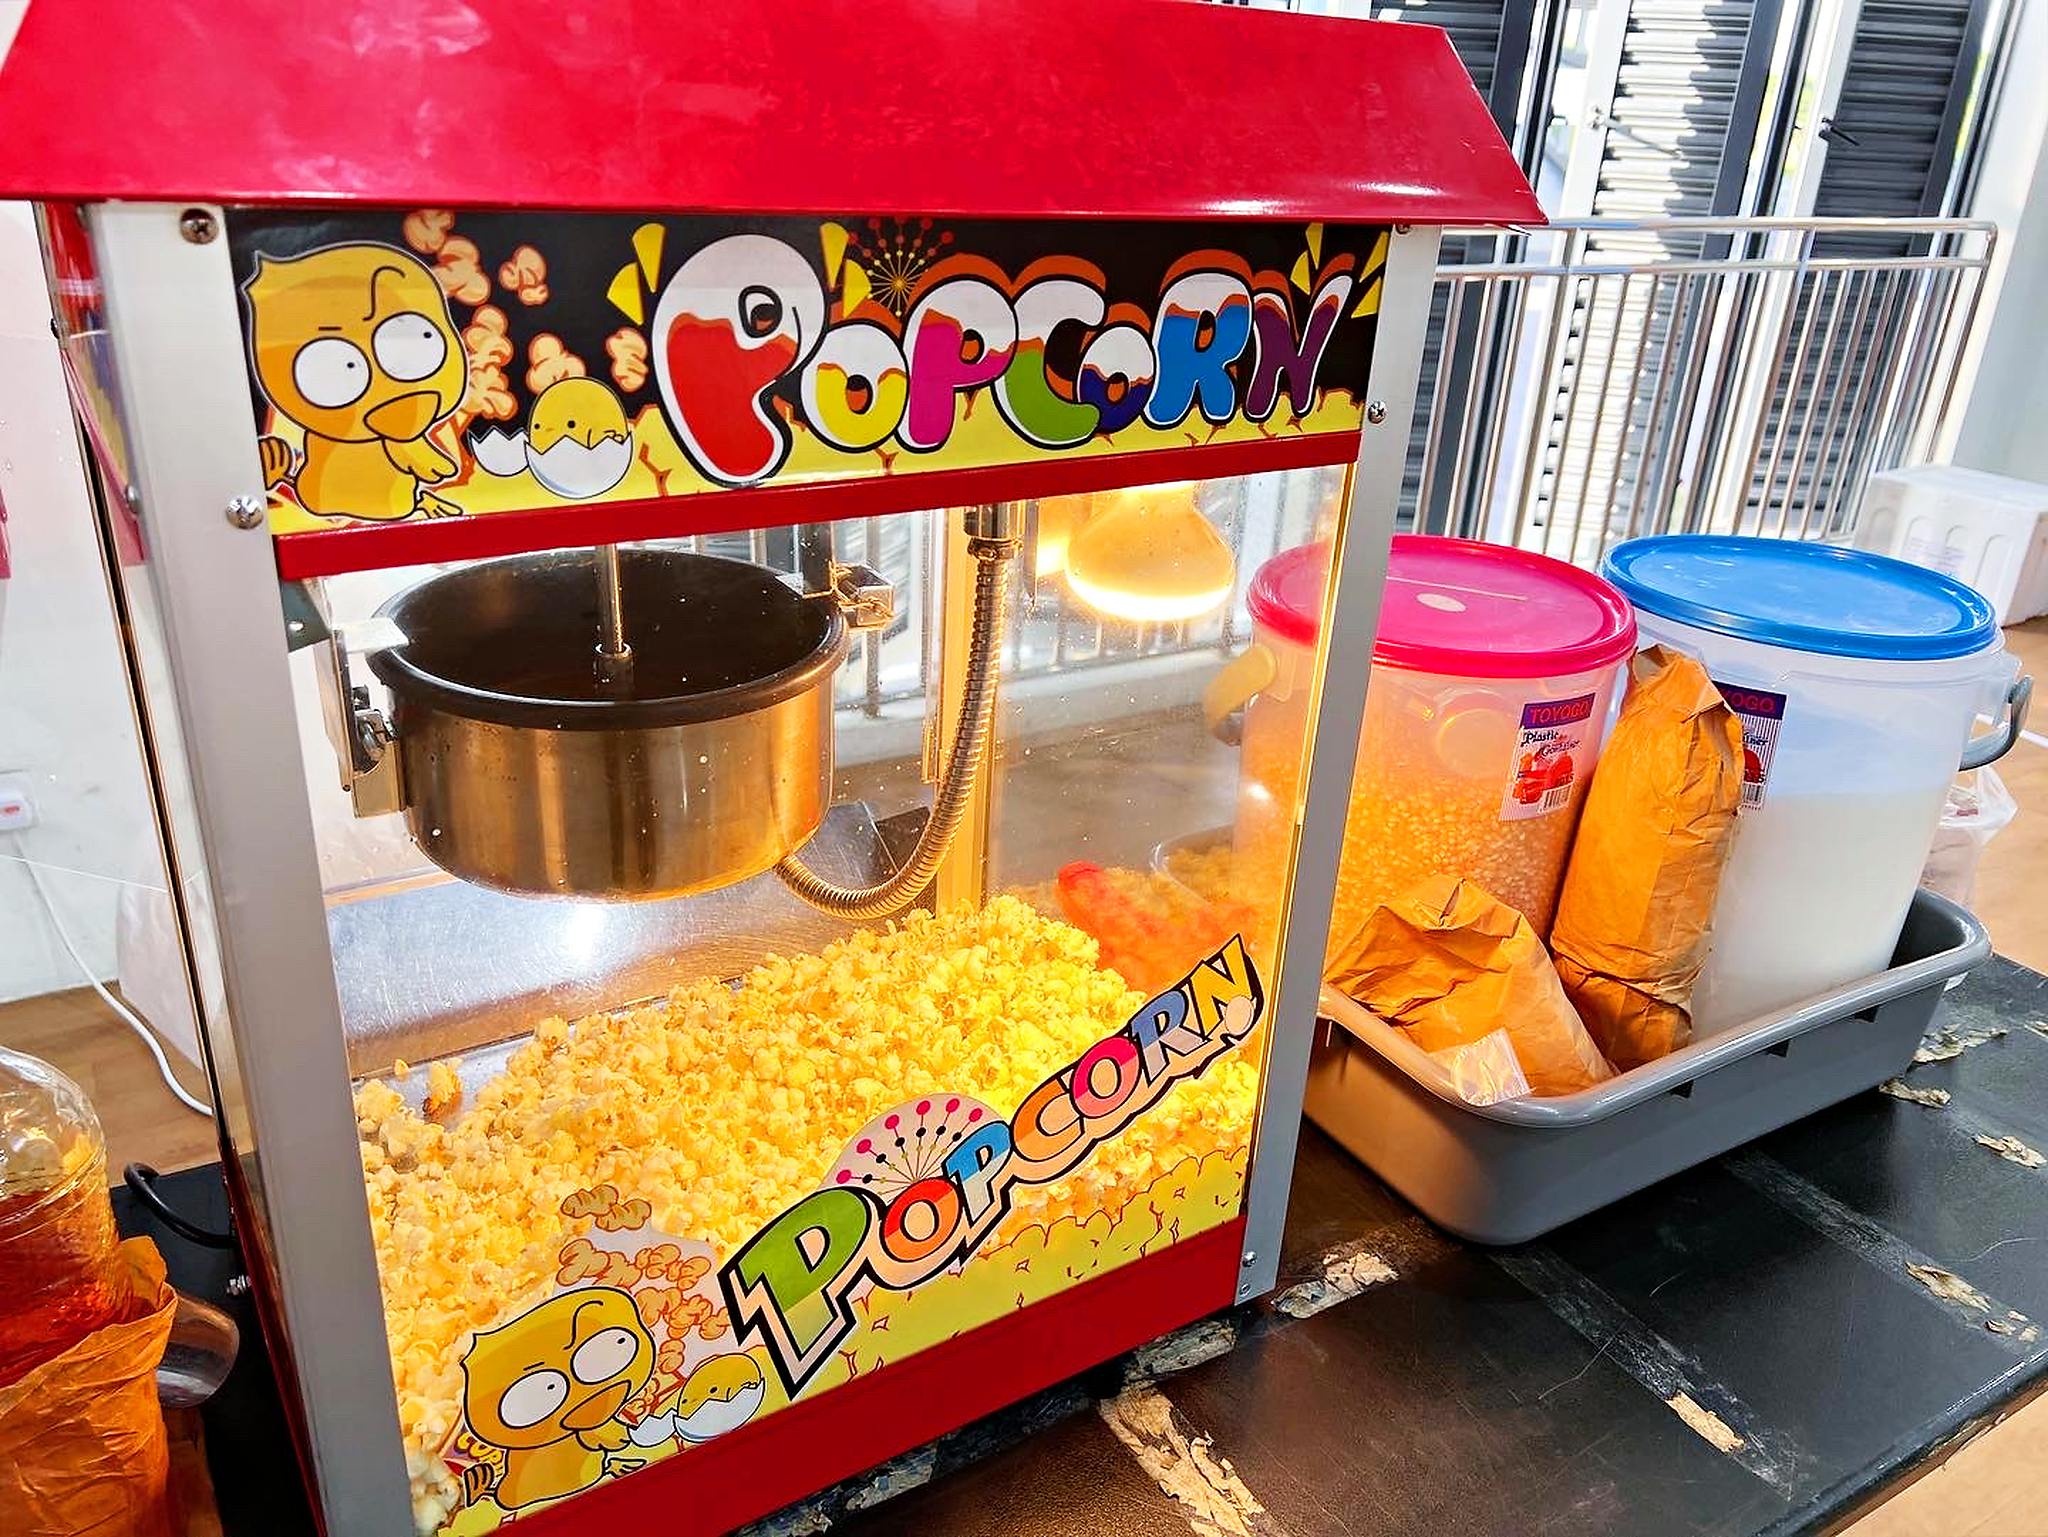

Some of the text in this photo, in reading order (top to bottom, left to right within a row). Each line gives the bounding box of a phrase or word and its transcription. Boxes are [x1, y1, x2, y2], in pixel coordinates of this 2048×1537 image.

[651, 232, 1354, 489] POPCORN
[1530, 701, 1589, 724] TOYOGO
[718, 933, 1264, 1400] POPCORN
